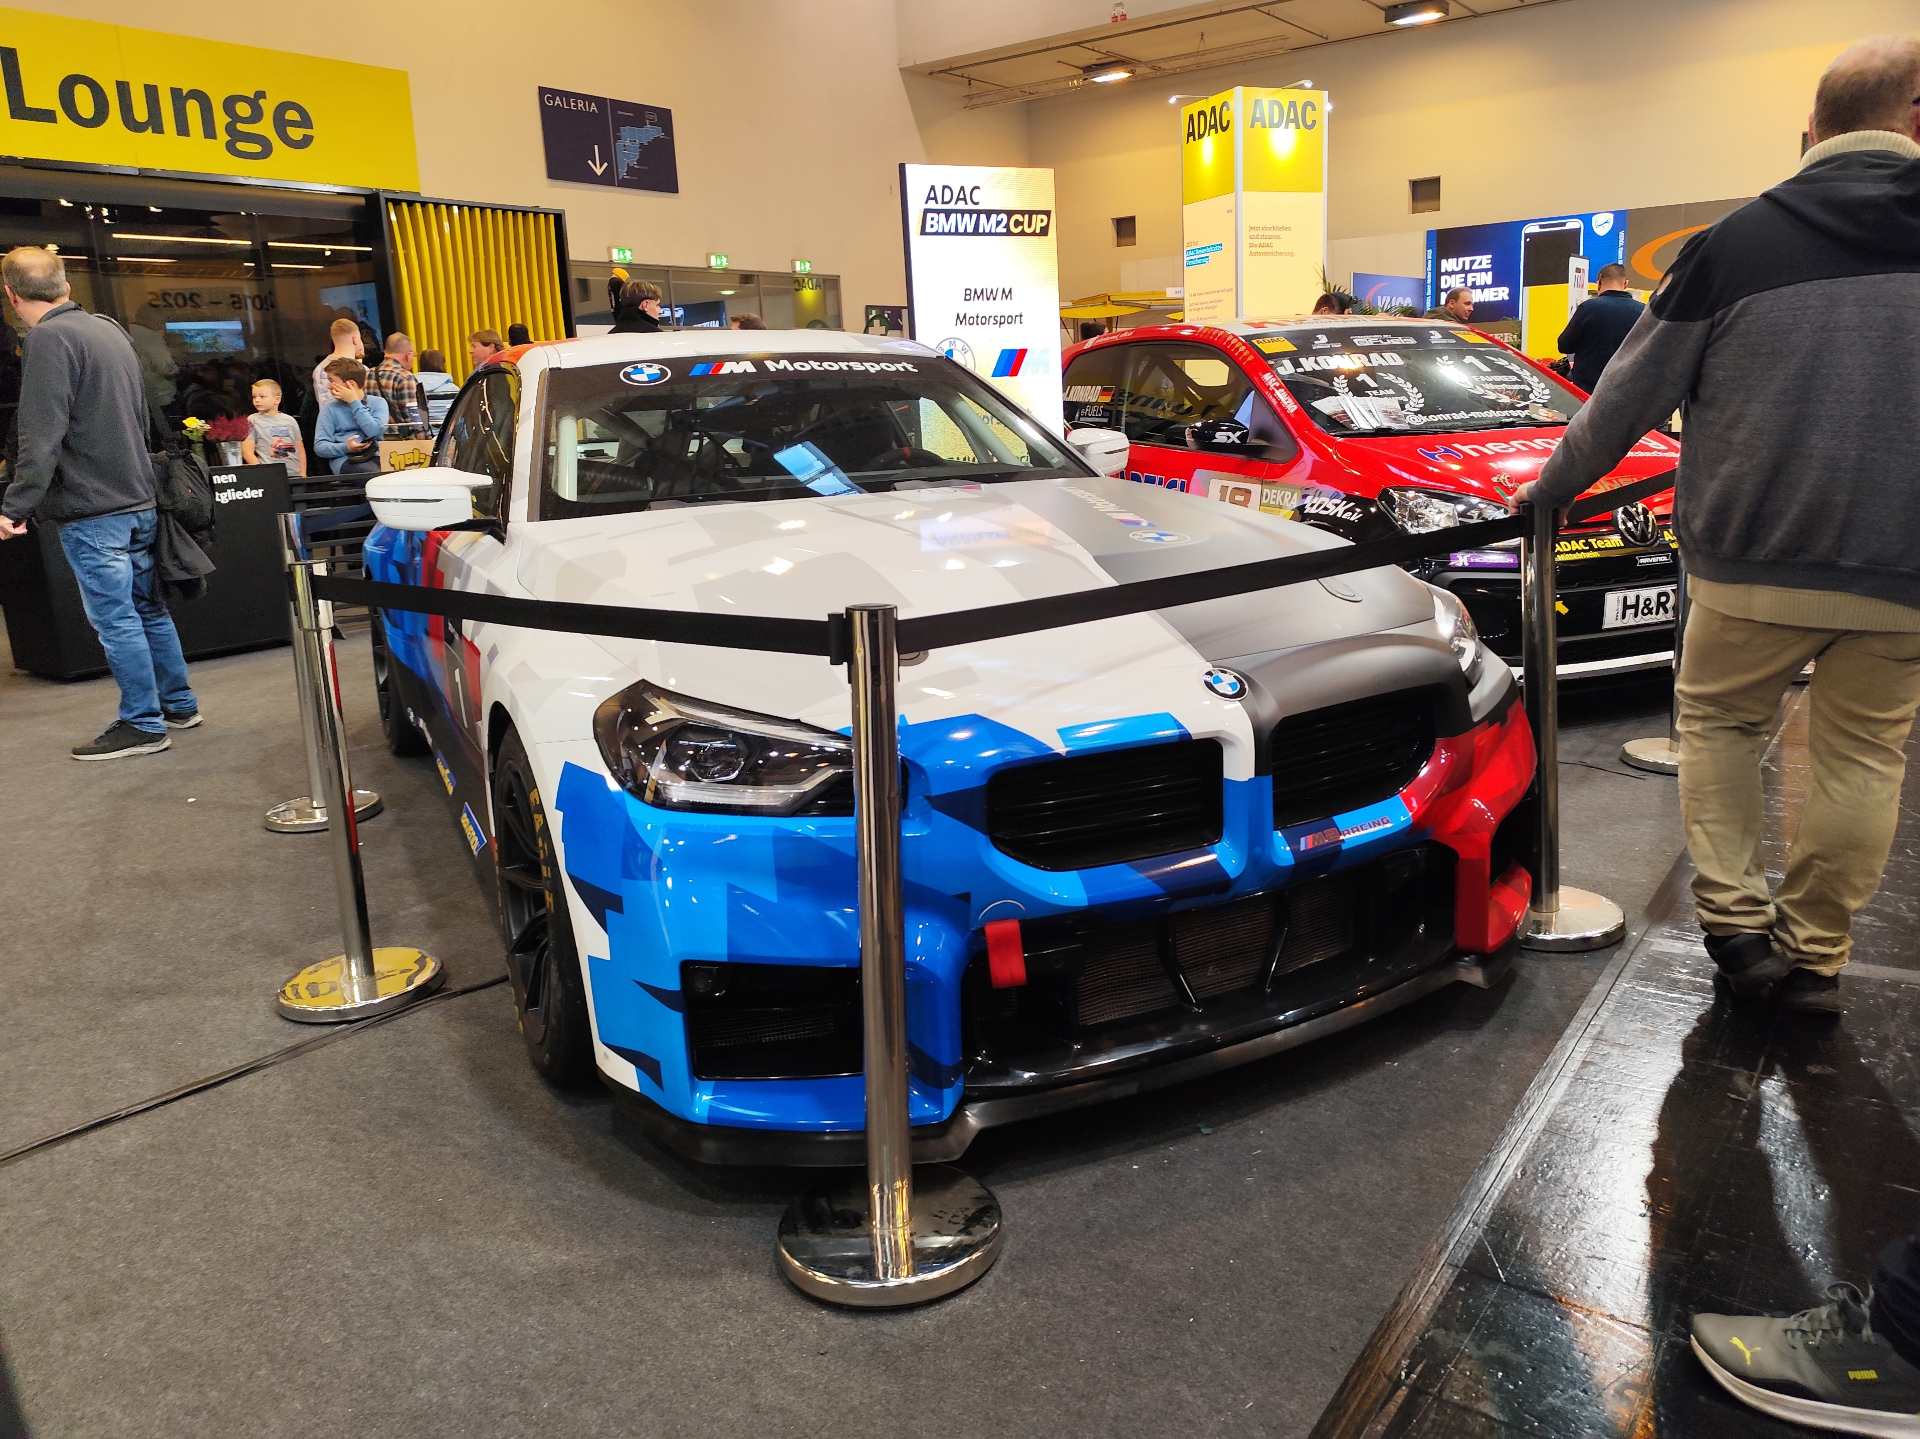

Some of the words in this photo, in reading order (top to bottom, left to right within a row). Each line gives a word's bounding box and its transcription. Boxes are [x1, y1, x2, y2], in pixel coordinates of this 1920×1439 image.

[0, 46, 315, 160] Lounge
[544, 94, 599, 113] GALERIA
[1186, 101, 1231, 144] ADAC
[1250, 99, 1317, 130] ADAC
[925, 185, 981, 206] ADAC
[925, 213, 977, 233] BMW
[979, 213, 1008, 233] M2
[1009, 213, 1048, 234] CUP
[1440, 254, 1493, 272] NUTZE
[1440, 273, 1466, 289] DIE
[1466, 271, 1493, 286] FIN
[964, 288, 999, 301] BMW
[1001, 288, 1013, 300] M
[955, 312, 1024, 328] Motorsport
[764, 360, 919, 374] Motorsport
[1276, 352, 1405, 376] J.KONRAD
[1463, 355, 1492, 372] 1
[1356, 373, 1379, 388] 1
[1365, 389, 1396, 397] TEAM
[1211, 431, 1242, 444] SX
[1262, 488, 1298, 508] DEKRA
[1555, 539, 1590, 553] ADAC
[1588, 538, 1625, 549] Team
[1621, 591, 1671, 620] H&R
[1340, 816, 1391, 837] RACING
